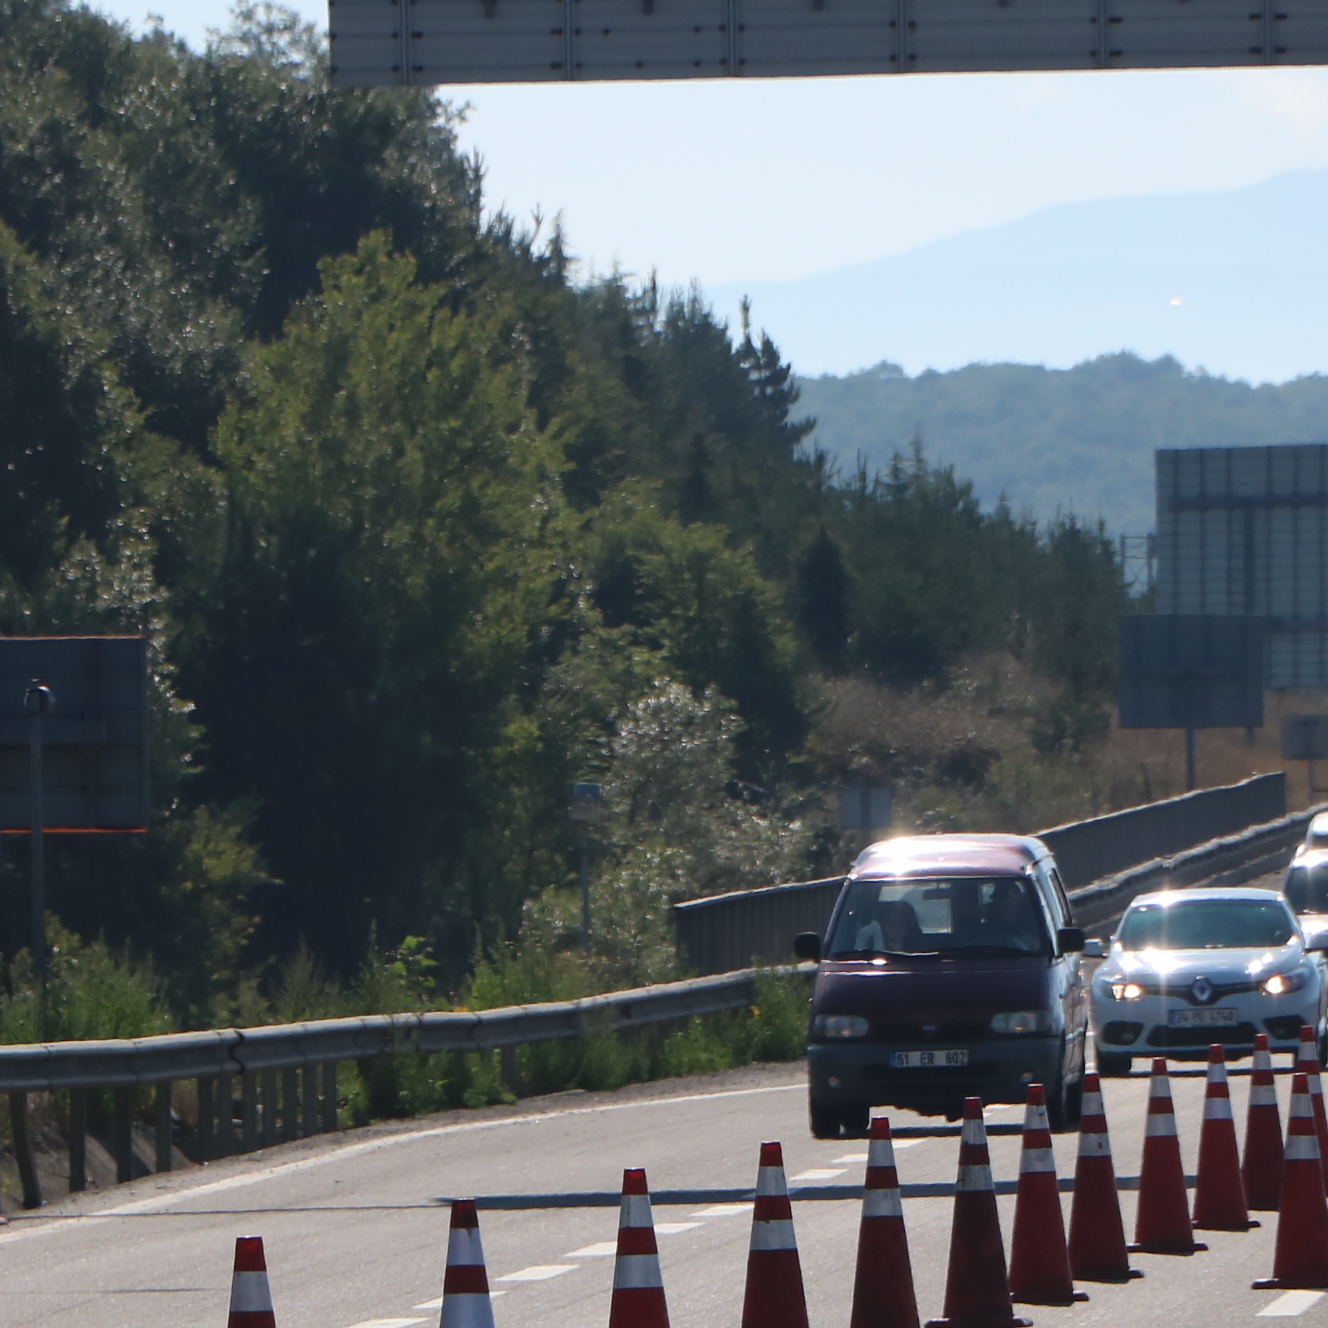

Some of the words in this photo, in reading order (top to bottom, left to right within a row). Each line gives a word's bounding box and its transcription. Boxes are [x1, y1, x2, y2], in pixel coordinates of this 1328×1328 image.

[1175, 1012, 1188, 1024] 34
[897, 1053, 909, 1066] 61
[919, 1052, 934, 1065] ER
